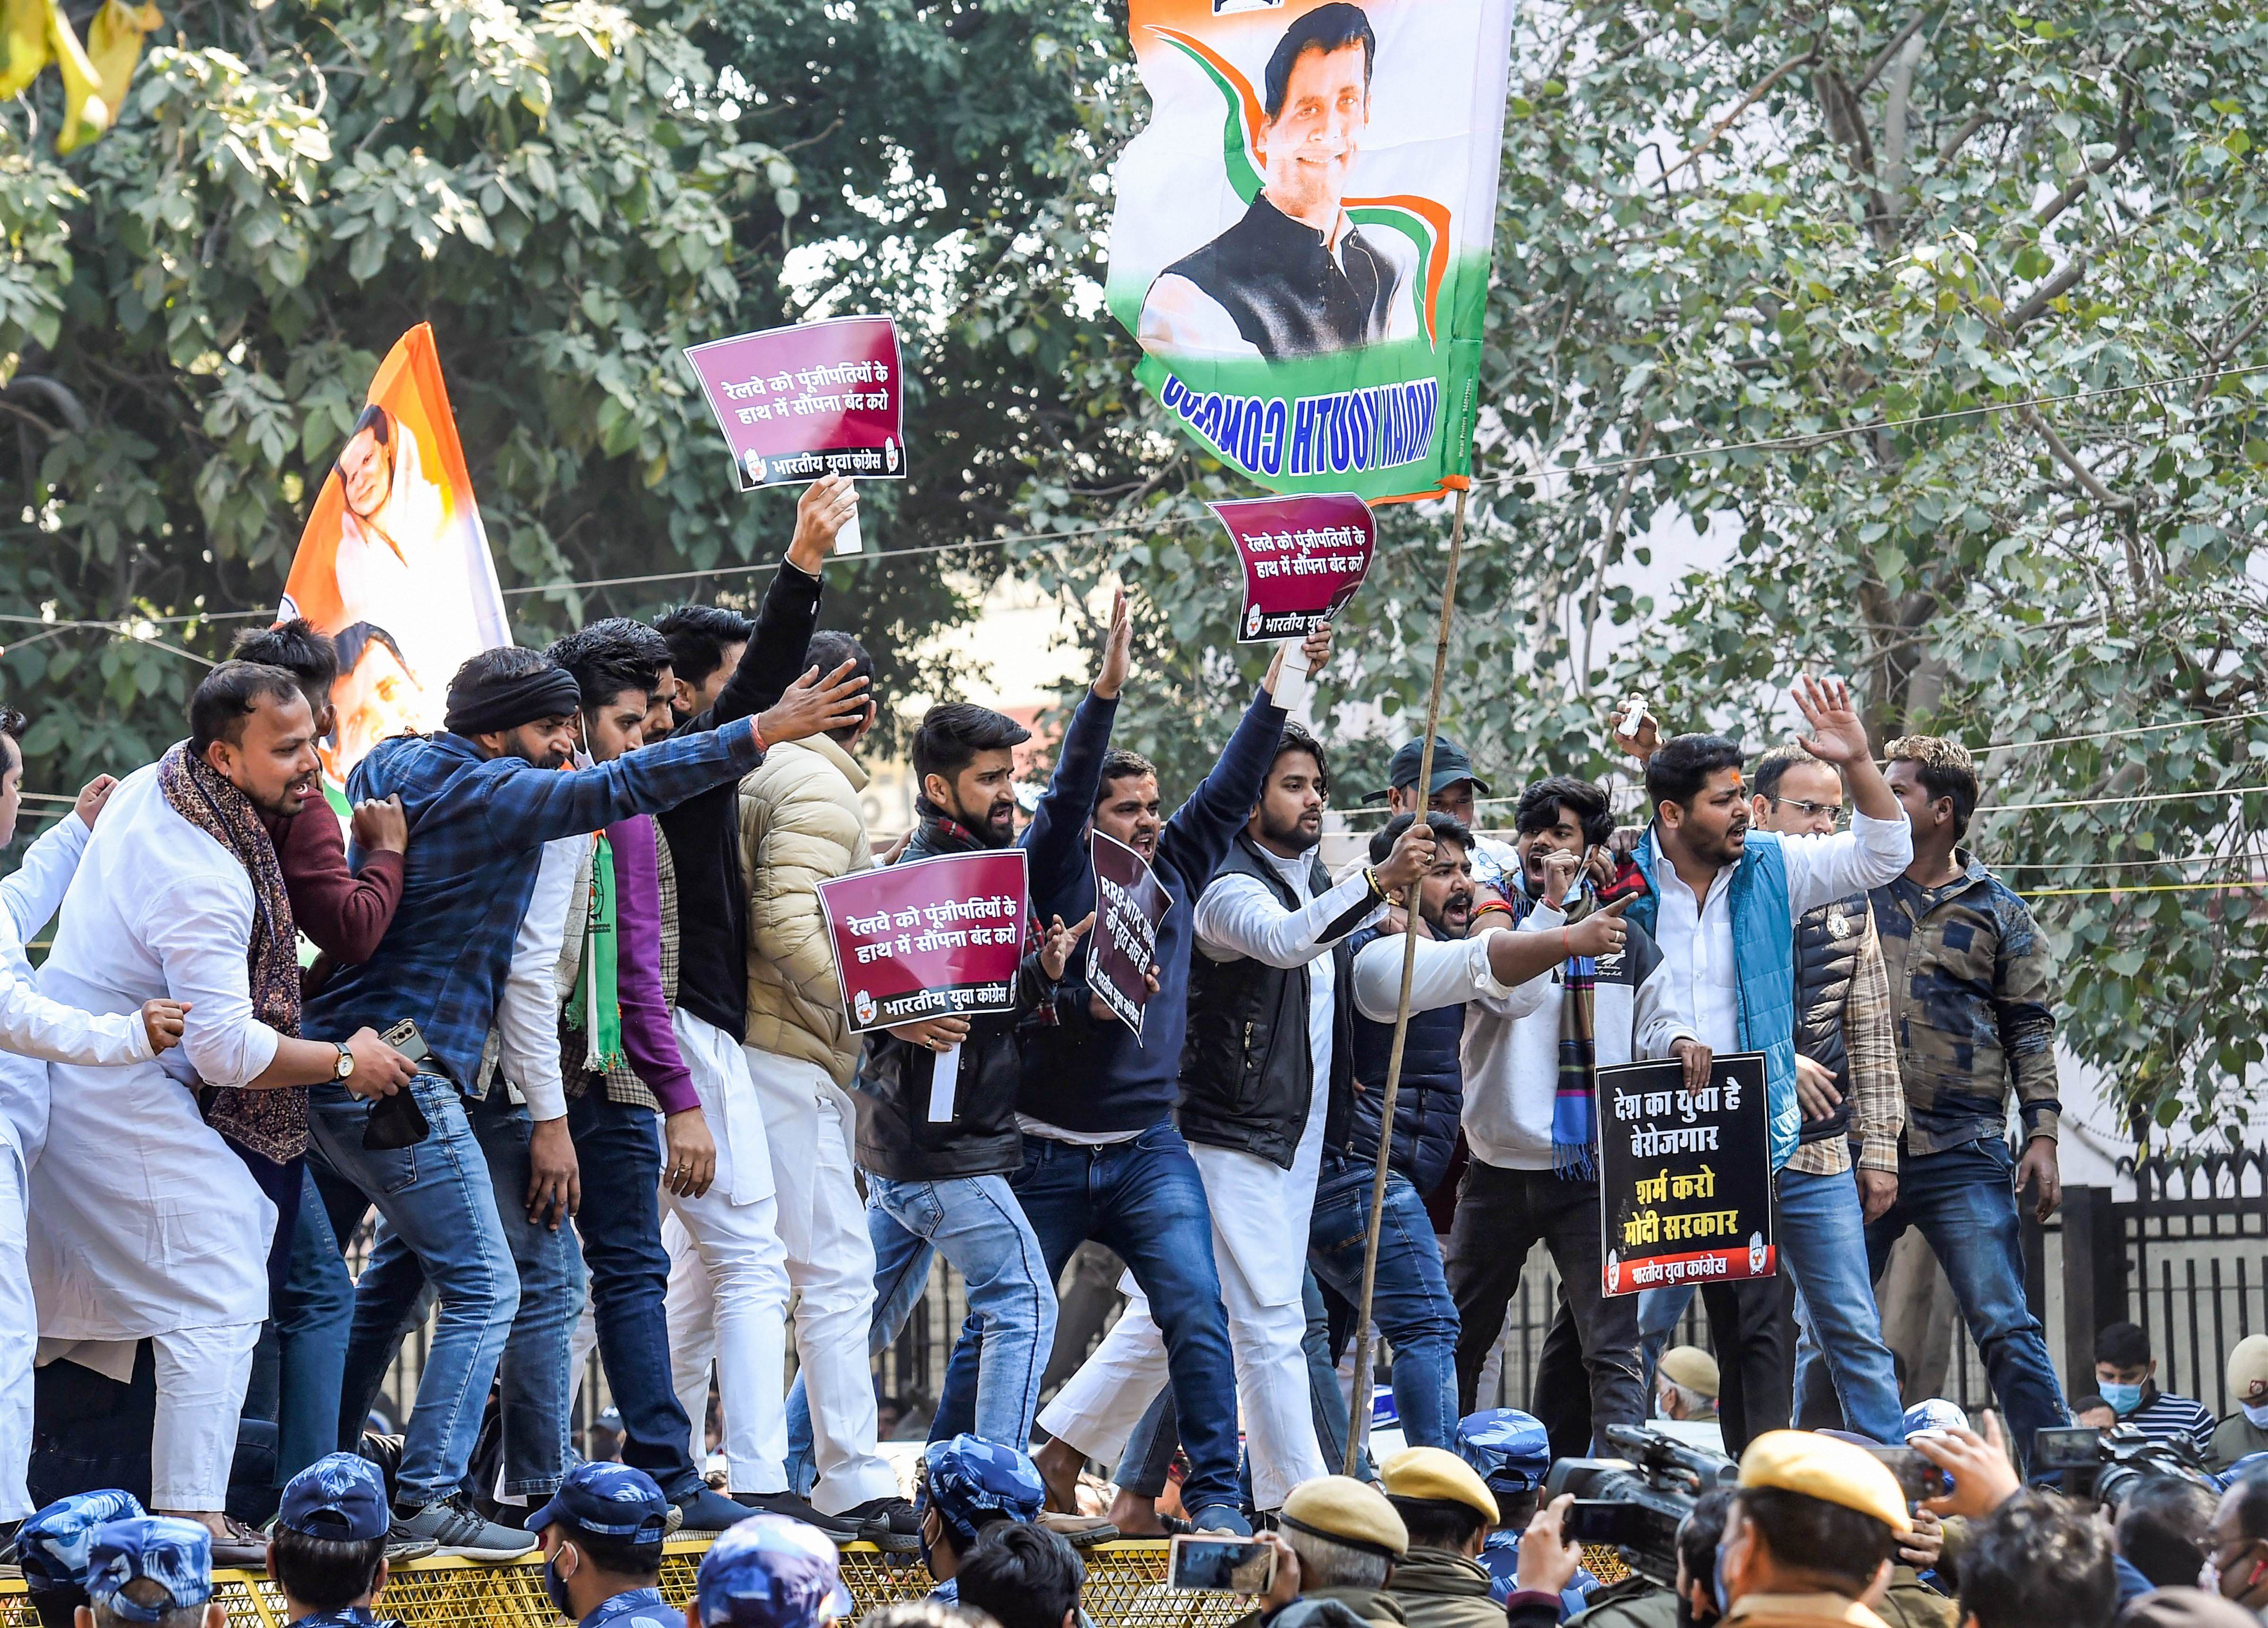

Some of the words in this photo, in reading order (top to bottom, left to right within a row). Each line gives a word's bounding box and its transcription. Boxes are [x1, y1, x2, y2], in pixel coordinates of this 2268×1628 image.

[721, 376, 766, 400] रेलवे
[767, 371, 795, 393] को
[796, 360, 873, 394] पूंजीपतियों
[873, 360, 888, 382] के
[735, 403, 772, 425] हाथ
[773, 396, 790, 418] में
[842, 390, 864, 411] बंद
[864, 388, 888, 410] करो
[772, 452, 824, 475] भारतीय
[825, 454, 851, 476] युवा
[852, 449, 881, 469] कांग्रेस
[1242, 532, 1275, 552] रेलवे
[1274, 531, 1295, 550] को
[1294, 527, 1352, 555] पूंजीपतियों
[1352, 526, 1365, 546] के
[1254, 559, 1279, 578] हाथ
[1280, 555, 1291, 575] में
[1328, 553, 1346, 573] बंद
[1347, 551, 1364, 572] करो
[1266, 612, 1306, 632] भारतीय
[846, 910, 891, 936] रेलवे
[893, 906, 921, 928] को
[923, 896, 1000, 929] पूंजीपतियों
[1003, 895, 1016, 917] के
[1100, 875, 1144, 933] RRB-NTPC
[855, 941, 893, 964] हाथ
[895, 934, 911, 955] में
[969, 924, 992, 945] बंद
[993, 922, 1016, 944] करो
[1106, 906, 1118, 935] की
[1114, 920, 1131, 950] तुरंत
[1126, 936, 1143, 966] जांच
[1139, 949, 1150, 976] हो
[884, 989, 945, 1016] भारतीय
[948, 989, 974, 1010] युवा
[976, 983, 1007, 1003] कांग्रेस
[1096, 968, 1114, 999] भारतीय
[1113, 987, 1124, 1010] युवा
[1124, 999, 1140, 1026] कांग्रेस
[1614, 1088, 1641, 1121] देश
[1644, 1091, 1672, 1117] का
[1676, 1087, 1718, 1123] युवा
[1723, 1077, 1742, 1111] है
[1630, 1123, 1719, 1158] बेरोजगार
[1635, 1168, 1668, 1205] शर्म
[1670, 1165, 1715, 1200] करो
[1624, 1209, 1660, 1246] मोदी
[1662, 1209, 1738, 1241] सरकार
[1632, 1260, 1664, 1285] भारतीय
[1665, 1260, 1684, 1284] युवा
[1685, 1254, 1727, 1276] कांग्रेस
